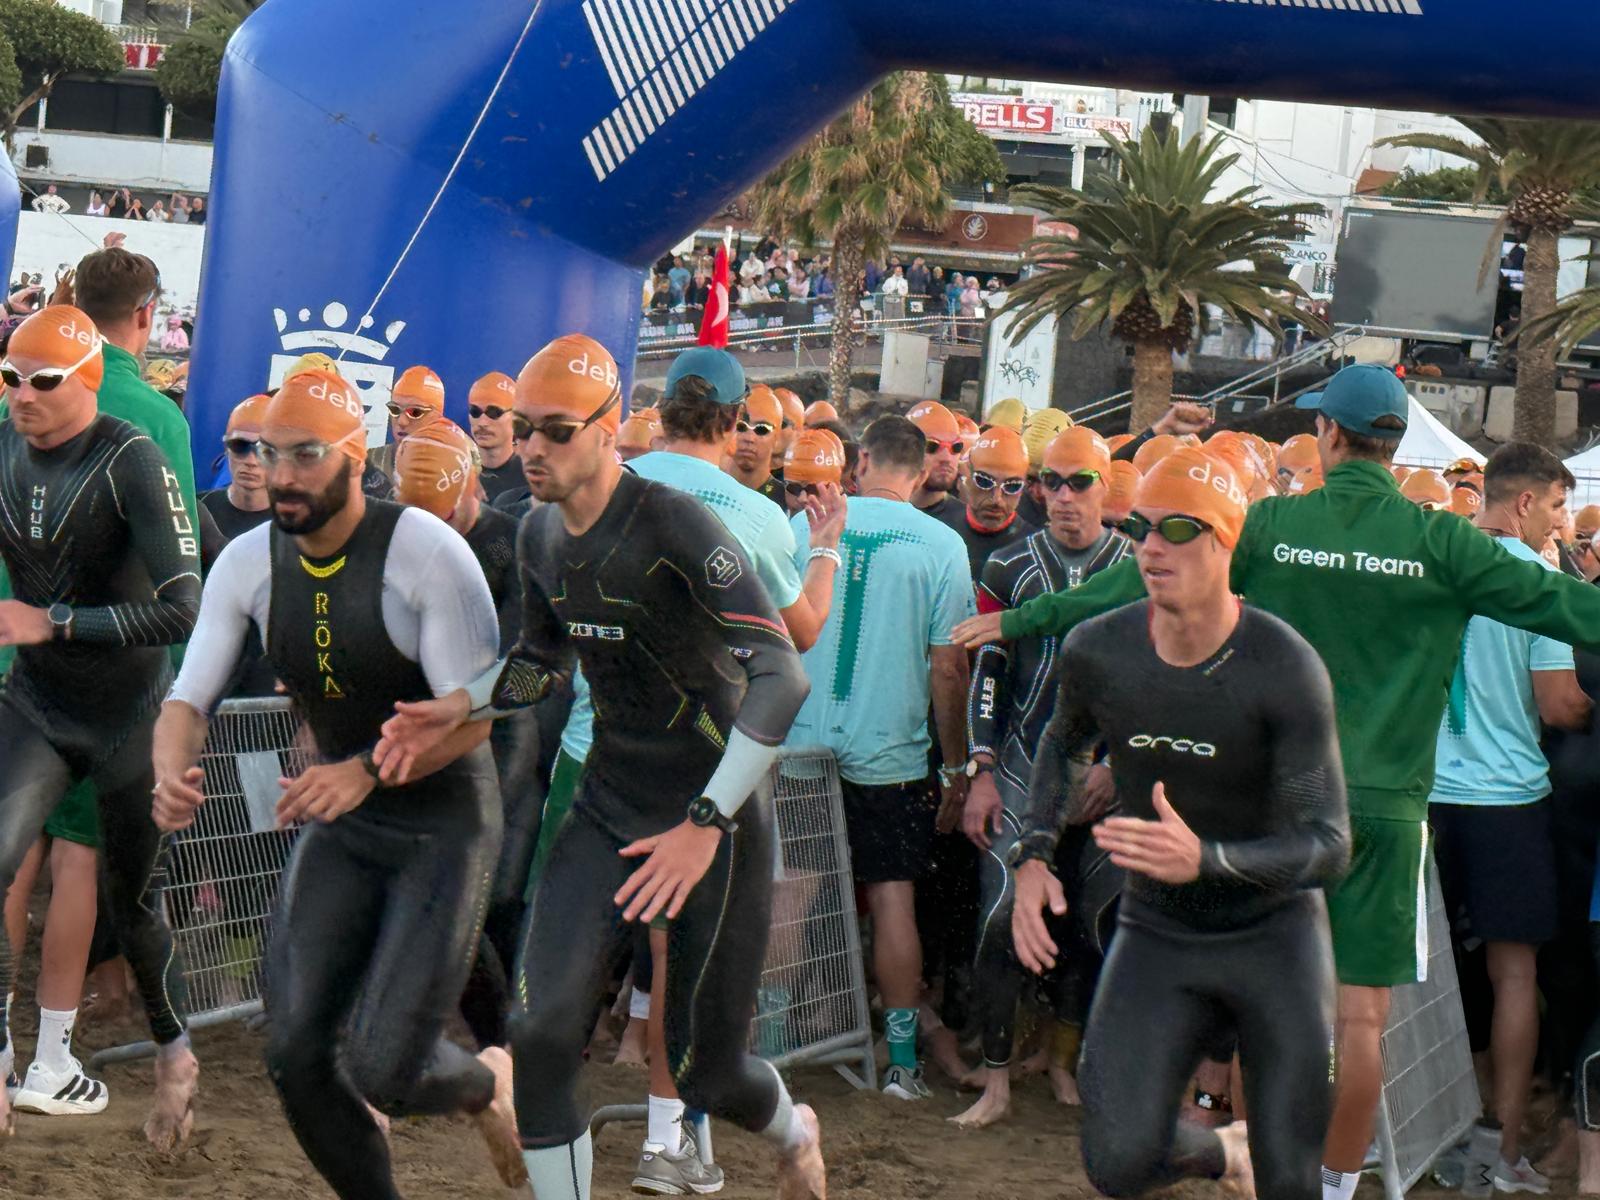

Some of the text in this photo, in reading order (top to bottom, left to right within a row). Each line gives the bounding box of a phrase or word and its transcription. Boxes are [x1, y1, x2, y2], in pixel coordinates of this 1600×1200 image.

[951, 102, 1047, 131] BELLS
[308, 380, 364, 418] deb
[162, 466, 198, 556] HUUB
[852, 549, 865, 581] TEAM
[1273, 543, 1424, 578] Green Team
[979, 676, 996, 719] HUUB
[1128, 734, 1216, 757] orca
